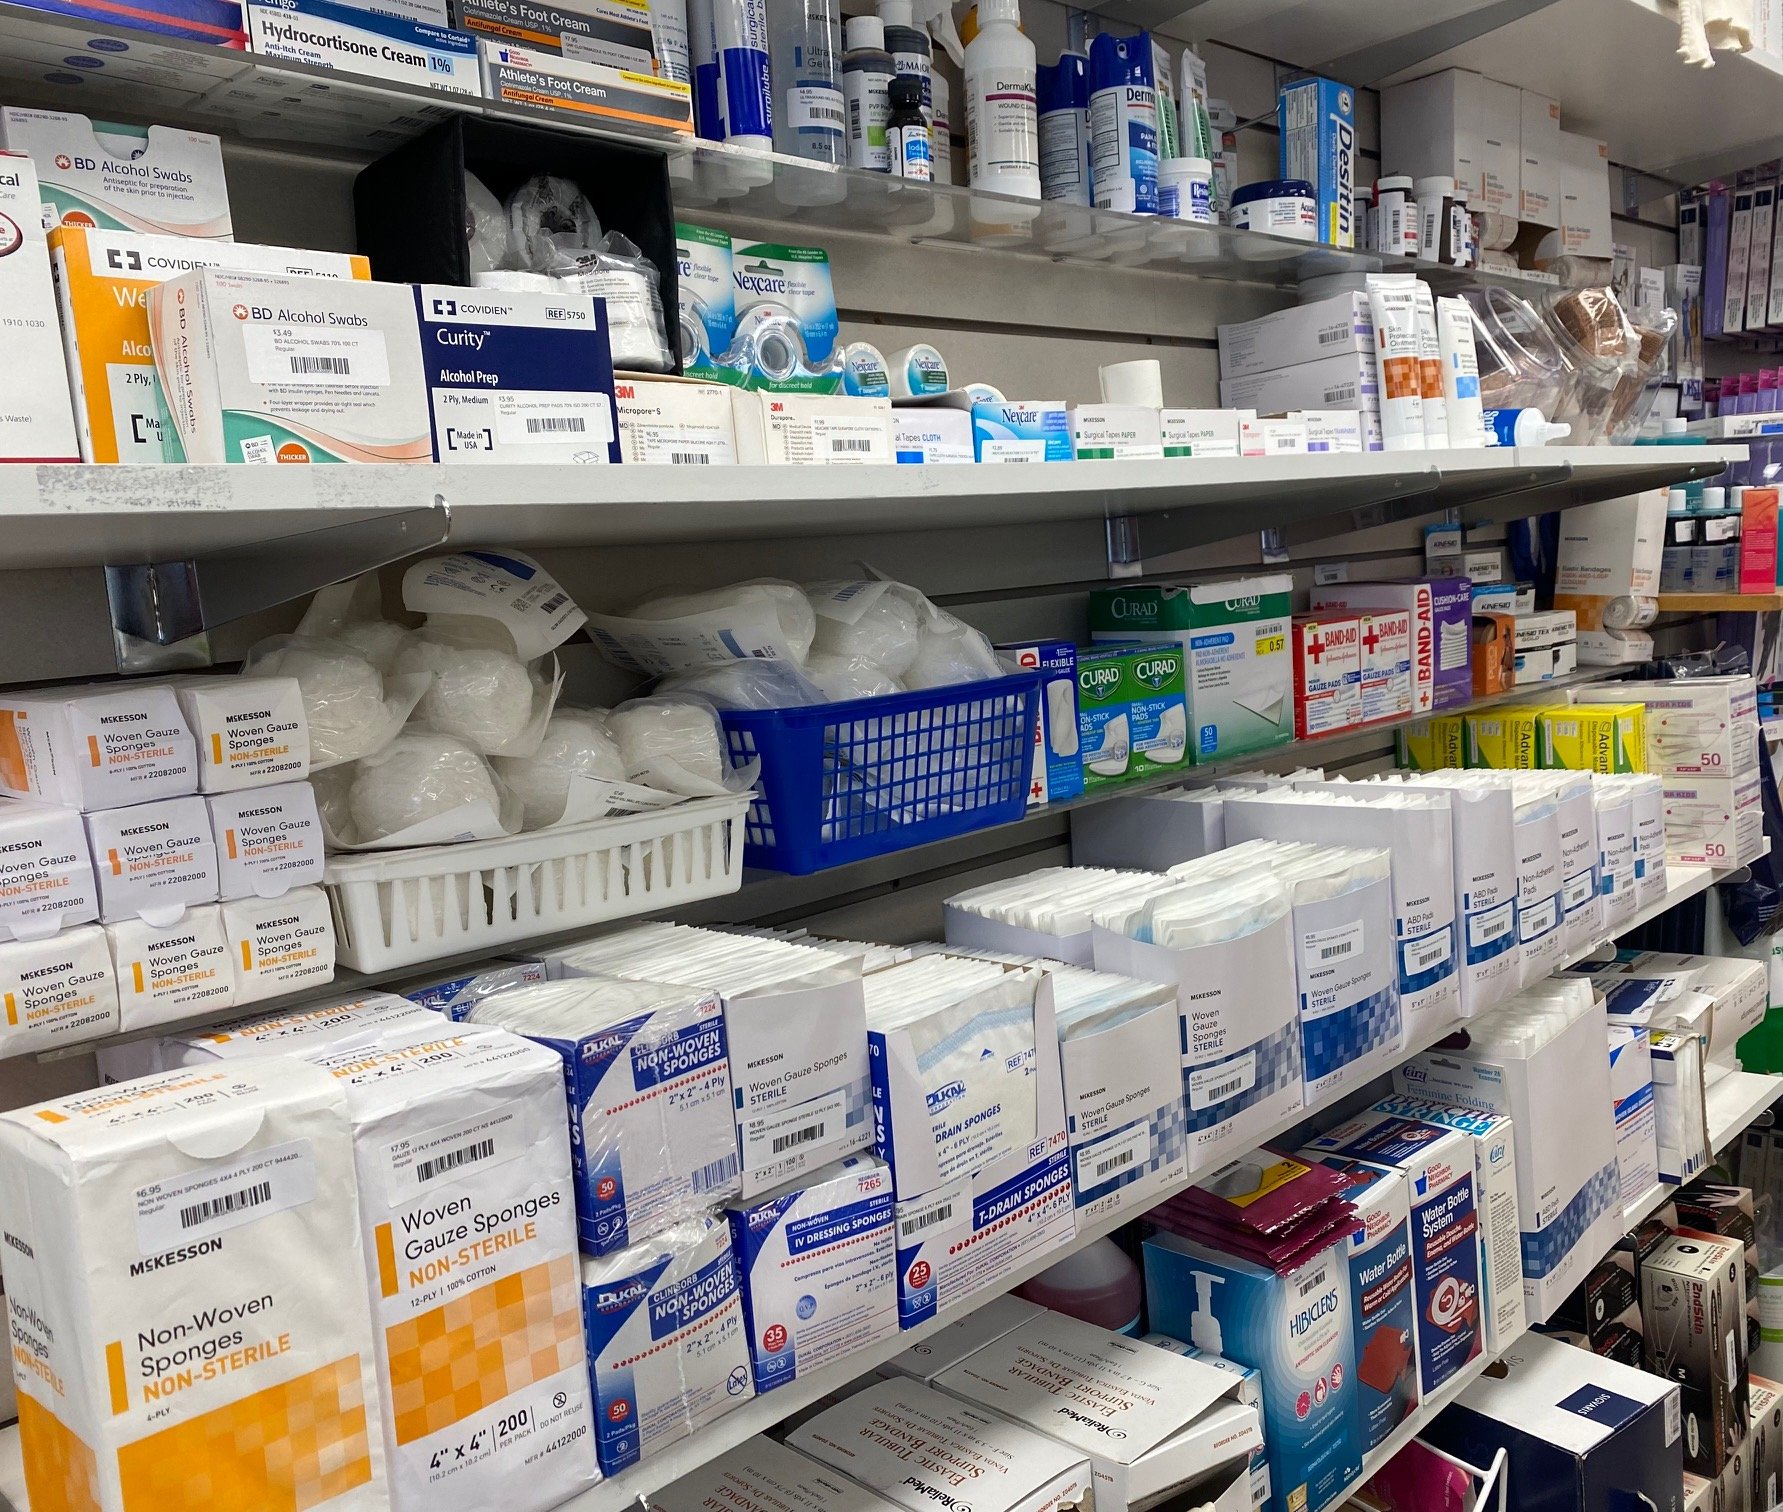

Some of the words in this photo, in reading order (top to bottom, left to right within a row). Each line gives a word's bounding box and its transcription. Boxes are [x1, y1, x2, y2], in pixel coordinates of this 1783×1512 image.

[415, 26, 439, 38] Compare
[440, 31, 446, 39] to
[467, 19, 500, 32] Antifungal
[501, 25, 523, 37] Cream
[262, 20, 377, 57] Hydrocortisone
[381, 46, 426, 67] Cream
[431, 56, 451, 72] 1%
[500, 68, 545, 87] Athlete's
[548, 77, 572, 91] Foot
[573, 82, 606, 98] Cream
[75, 157, 96, 171] BD
[101, 161, 149, 178] Alcohol
[153, 166, 193, 184] Swabs
[103, 177, 136, 189] Antiseptic
[137, 180, 149, 190] for
[150, 182, 187, 193] preparation
[1339, 126, 1353, 234] Desitin
[707, 275, 719, 283] tape
[733, 270, 785, 295] Nexcare
[787, 280, 806, 288] flexible
[802, 289, 815, 297] tape
[252, 307, 273, 319] BD
[278, 309, 325, 324] Alcohol
[328, 313, 368, 326] Swabs
[549, 310, 563, 319] REF
[567, 311, 585, 320] 5750
[1388, 326, 1402, 334] Skin
[437, 329, 490, 350] Curity™
[441, 369, 474, 383] Alcohol
[476, 372, 498, 386] Prep
[444, 395, 448, 403] 2
[449, 396, 460, 405] Ply,
[462, 396, 488, 404] Medium
[615, 386, 634, 399] 3M
[770, 403, 783, 411] 3M
[5, 415, 31, 423] Waste)
[1002, 408, 1038, 426] Nexcare
[456, 431, 473, 439] Made
[902, 432, 921, 442] Tapes
[922, 433, 941, 442] CLOTH
[1084, 430, 1104, 440] Surgical
[1106, 431, 1121, 440] Tapes
[1122, 430, 1136, 440] PAPER
[464, 441, 478, 449] USA
[1434, 592, 1469, 606] CUSHION-CARE
[1481, 602, 1510, 610] KINESIO
[1325, 628, 1356, 646] BAND-AID
[1418, 588, 1431, 682] BAND-AID
[1269, 639, 1284, 652] 0.57
[1079, 667, 1119, 688] CURAD
[1137, 659, 1176, 680] CURAD
[1363, 671, 1381, 680] GAUZE
[1382, 668, 1394, 676] PADS
[1309, 682, 1327, 692] GAUZE
[1328, 680, 1341, 688] PADS
[226, 710, 271, 723] McKESSON
[1132, 702, 1165, 714] NON-STICK
[101, 713, 147, 724] McKESSON
[1132, 713, 1149, 721] PADS
[104, 731, 142, 744] Woven
[146, 727, 180, 739] Gauze
[228, 726, 264, 738] Woven
[267, 721, 298, 734] Gauze
[267, 762, 301, 774] 22082000
[1701, 753, 1721, 766] 50
[149, 766, 186, 779] 22082000
[239, 806, 282, 819] McKESSON
[240, 825, 277, 837] Woven
[280, 819, 310, 831] Gauze
[1705, 844, 1725, 856] 50
[1523, 885, 1537, 896] Pads
[1407, 916, 1421, 925] ABD
[1422, 911, 1433, 920] Pads
[1407, 922, 1431, 934] STERILE
[24, 989, 77, 1009] Sponges
[1311, 995, 1336, 1008] STERILE
[27, 995, 95, 1021] NON-STERILE
[1192, 1009, 1220, 1021] Woven
[637, 1030, 719, 1072] NON-WOVEN
[1407, 1083, 1453, 1100] Feminine
[1456, 1093, 1494, 1111] Folding
[935, 1122, 961, 1144] DRAIN
[964, 1104, 1001, 1130] SPONGES
[1379, 1102, 1493, 1132] SYRINGE
[390, 1141, 410, 1152] $7.95
[1029, 1141, 1046, 1156] REF
[1048, 1131, 1066, 1147] 7470
[1428, 1163, 1441, 1174] GOOD
[136, 1185, 161, 1197] $6.95
[138, 1197, 154, 1208] NON
[156, 1188, 183, 1203] WOVEN
[184, 1179, 218, 1194] SPONGES
[220, 1175, 233, 1184] 4X4
[239, 1167, 251, 1177] PLY
[252, 1163, 264, 1173] 200
[265, 1160, 273, 1168] CT
[601, 1181, 613, 1192] 50
[858, 1178, 881, 1192] 7265
[869, 1196, 889, 1207] STERILE
[979, 1191, 1021, 1225] T-DRAIN
[1024, 1164, 1069, 1196] SPONGES
[139, 1203, 165, 1216] Regular
[1421, 1200, 1446, 1224] Water
[1447, 1187, 1469, 1211] Bottle
[405, 1224, 467, 1260] Gauze
[474, 1191, 561, 1233] Sponges
[795, 1238, 804, 1248] IV
[807, 1221, 850, 1245] DRESSING
[852, 1209, 891, 1230] SPONGES
[1422, 1213, 1453, 1239] System
[409, 1222, 537, 1289] NON-STERILE
[912, 1264, 926, 1278] 25
[1359, 1266, 1385, 1286] Water
[1386, 1243, 1406, 1267] Bottle
[410, 1290, 437, 1307] 12-PLY
[446, 1277, 465, 1292] 100%
[466, 1264, 496, 1283] COTTON
[655, 1262, 732, 1320] NON-WOVEN
[1290, 1288, 1338, 1338] HIBICLENS
[137, 1294, 273, 1352] Non-Woven
[767, 1326, 783, 1341] 35
[141, 1330, 243, 1377] Sponges
[143, 1333, 291, 1403] NON-STERILE
[1577, 1392, 1611, 1415] SIGVARIS
[498, 1409, 528, 1437] 200
[540, 1419, 549, 1429] DO
[550, 1412, 563, 1425] NOT
[564, 1402, 583, 1417] REUSE
[500, 1436, 513, 1448] PER
[514, 1427, 531, 1442] PACK
[868, 1418, 926, 1450] BANDAGE
[859, 1427, 912, 1462] TUBULAR
[925, 1444, 986, 1480] SUPPORT
[913, 1455, 967, 1488] ELASTIC
